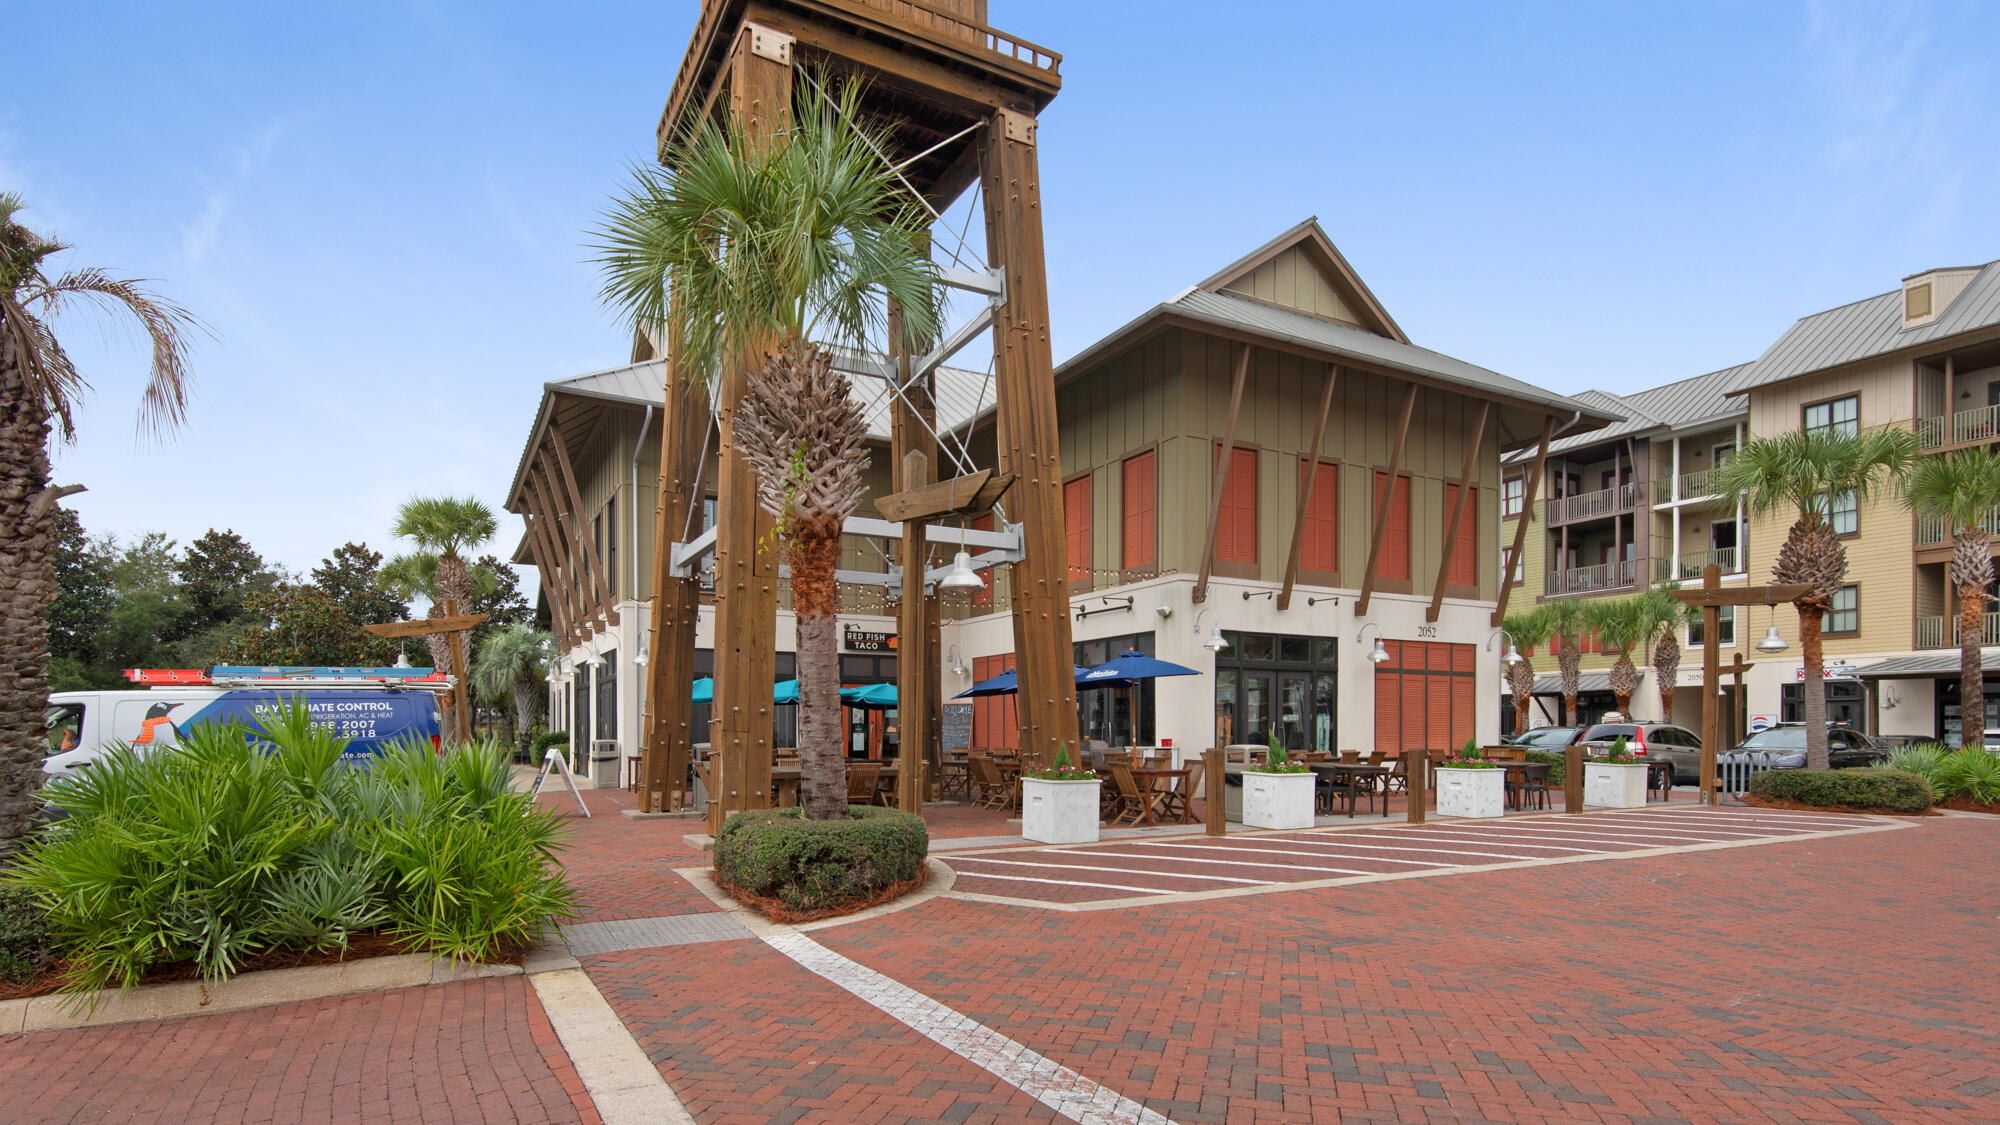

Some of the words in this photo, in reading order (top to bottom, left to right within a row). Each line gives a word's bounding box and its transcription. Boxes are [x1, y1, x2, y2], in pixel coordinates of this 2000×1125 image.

[847, 632, 864, 640] RED
[866, 633, 885, 641] FISH
[1418, 626, 1436, 638] 2052
[854, 642, 878, 650] TACO
[336, 702, 393, 711] CONTROL
[377, 711, 393, 719] HEAT
